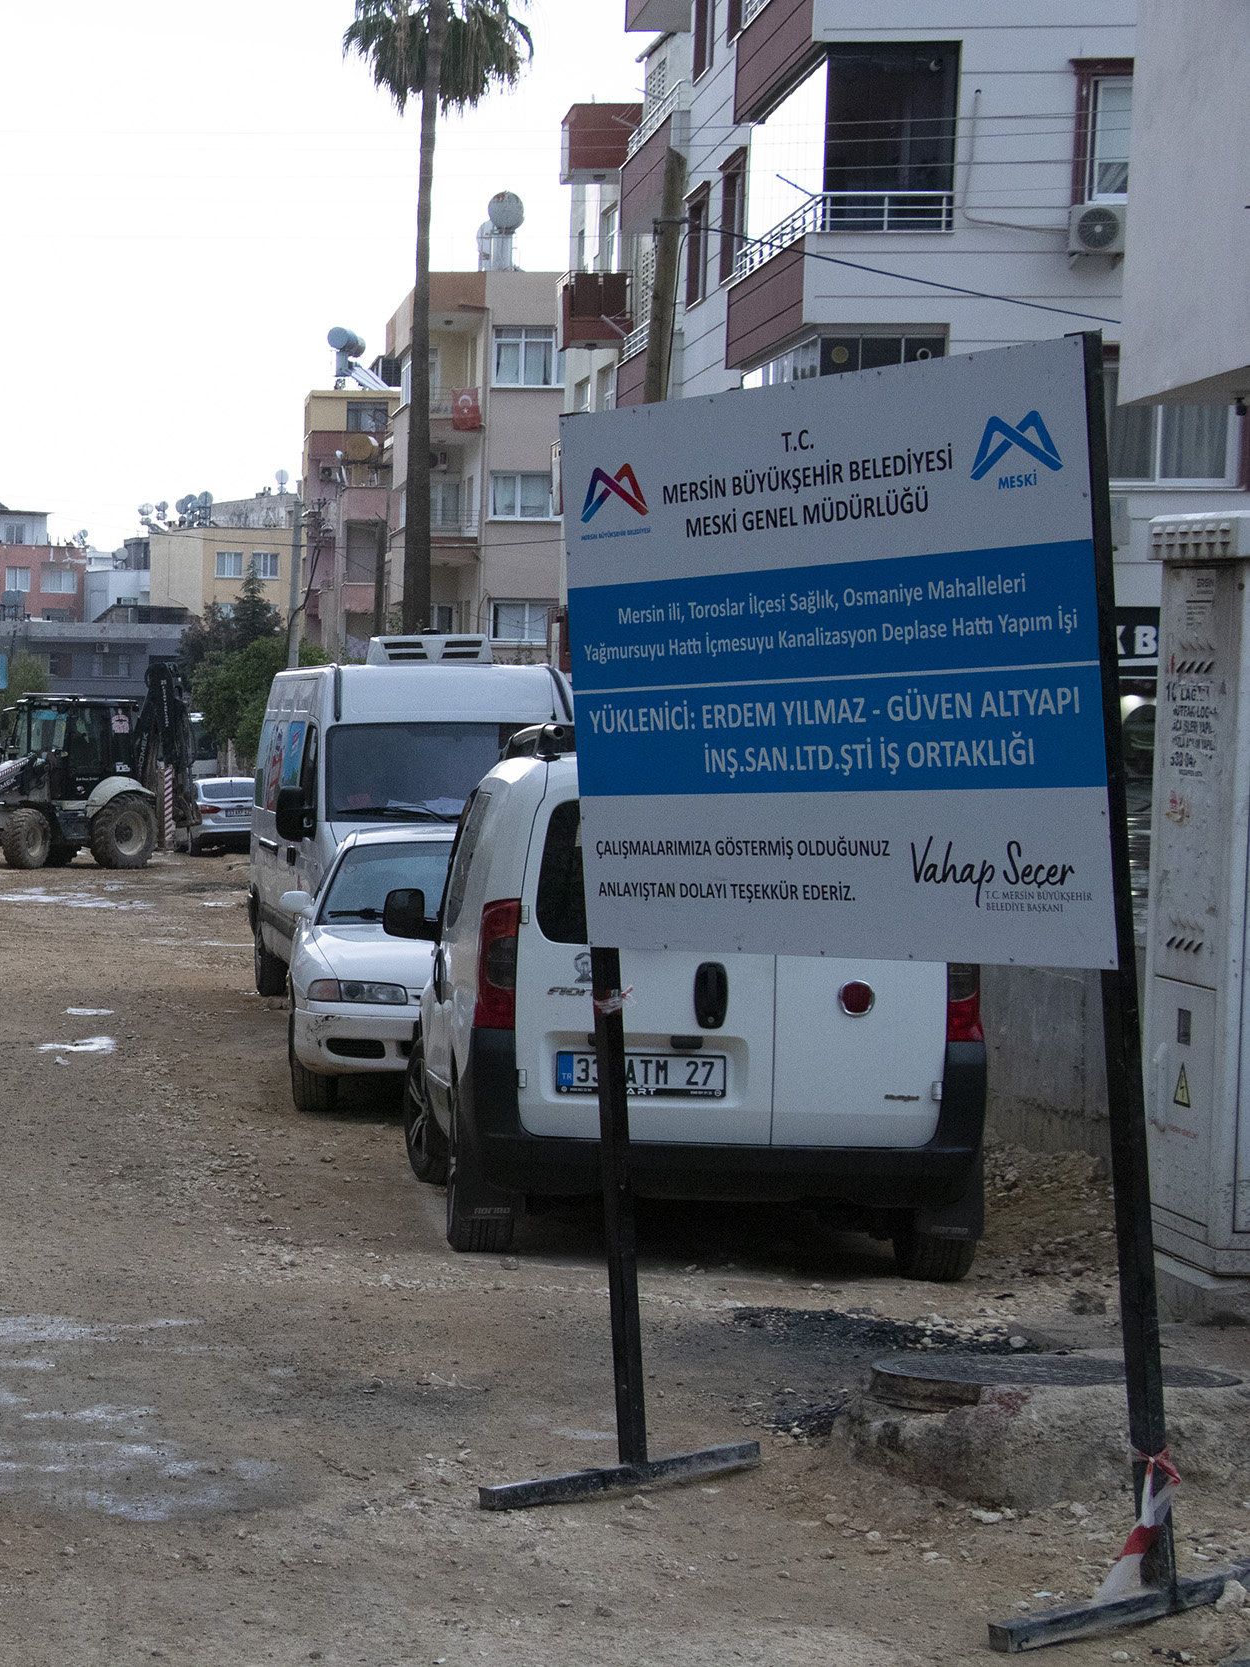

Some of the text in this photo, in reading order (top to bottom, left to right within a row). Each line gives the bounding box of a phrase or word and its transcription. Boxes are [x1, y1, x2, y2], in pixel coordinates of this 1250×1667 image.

[781, 429, 815, 452] T.C.
[662, 442, 953, 505] MERSİN BÜYÜKŞEHİR BELEDİYESİ
[998, 469, 1037, 490] MESKİ
[686, 485, 929, 538] MESKİ GENEL MÜDÜRLÜĞÜ
[618, 573, 1026, 625] Mersin ili, Toroslar İlçesi Sağlık, Osmaniye Mahalleleri
[584, 605, 1078, 664] Yağmursuyu Hattı İçmesuyu Kanalizasyon Deplase Hattı Yapım İşi
[589, 700, 696, 734] YÜKLENİCİ:
[702, 702, 776, 729] ERDEM
[782, 697, 867, 726] YILMAZ
[887, 688, 972, 722] GÜVEN
[980, 686, 1080, 718] ALTYAPI
[704, 731, 1035, 779] İNŞ.SAN.LTD.ŞTİ İŞ ORTAKLIĞI
[596, 836, 890, 860] ÇALIŞMALARIMIZA GÖSTERMİŞ OLDUĞUNUZ
[911, 835, 1075, 908] Vahap Seçer
[599, 880, 856, 903] ANLAYIŞTAN DOLAYI TEŞEKKÜR EDERİZ.
[984, 889, 1093, 903] T.C. MERSİN BÜYÜKŞEHİR
[986, 903, 1064, 913] BELEDİYE BAŞKANI
[626, 1059, 668, 1086] ATM
[686, 1061, 715, 1086] 27
[626, 1087, 657, 1096] ART
